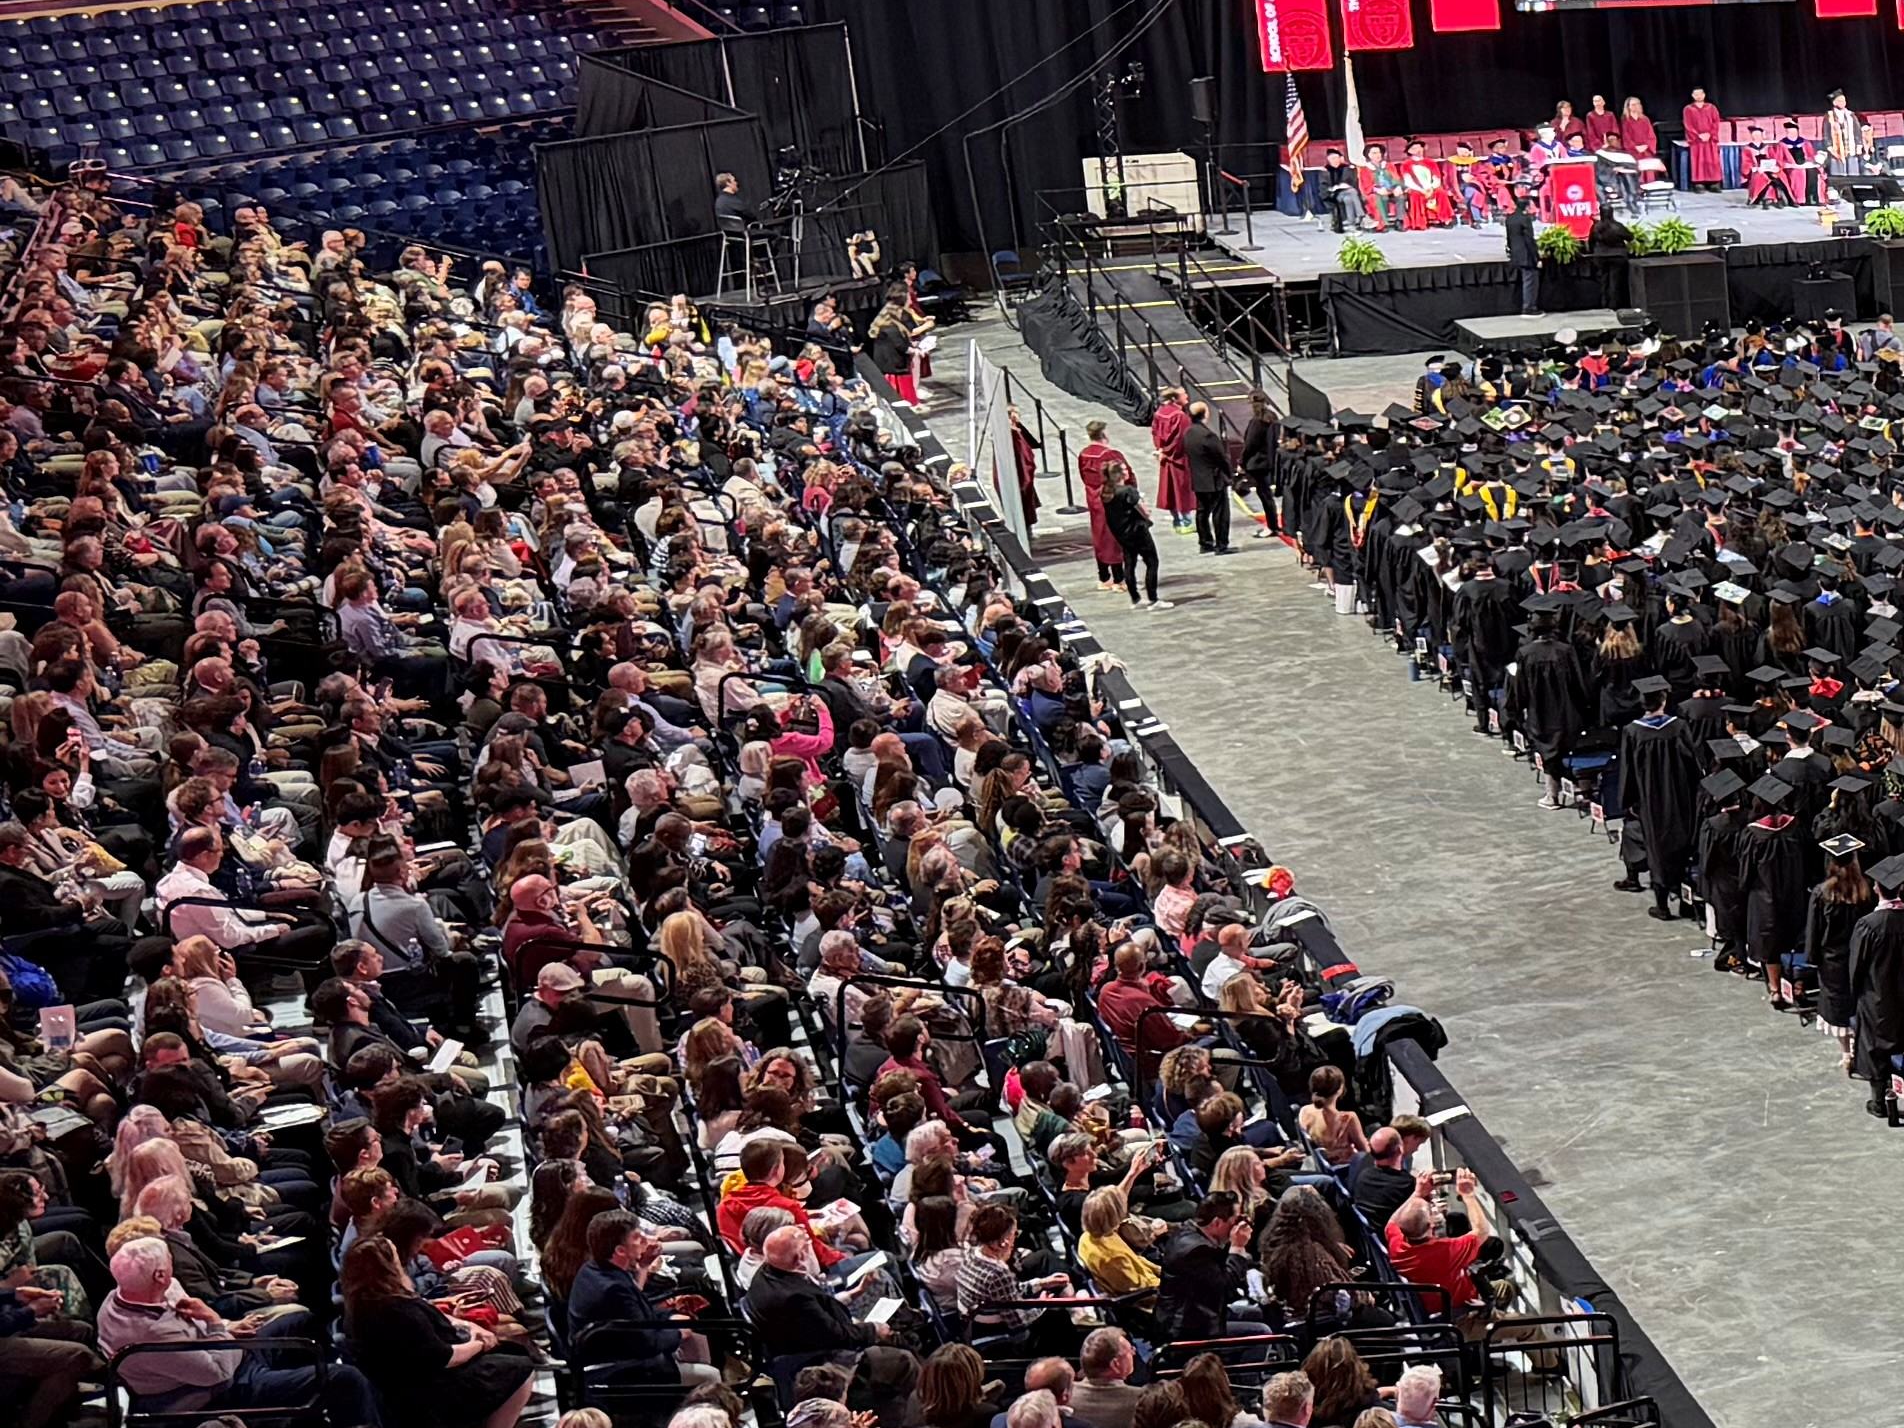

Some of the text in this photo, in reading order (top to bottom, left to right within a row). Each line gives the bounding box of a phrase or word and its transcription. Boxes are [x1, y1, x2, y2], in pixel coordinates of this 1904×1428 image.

[1264, 3, 1277, 18] OF
[1268, 18, 1283, 63] SCHOOL
[1558, 202, 1592, 218] WPI
